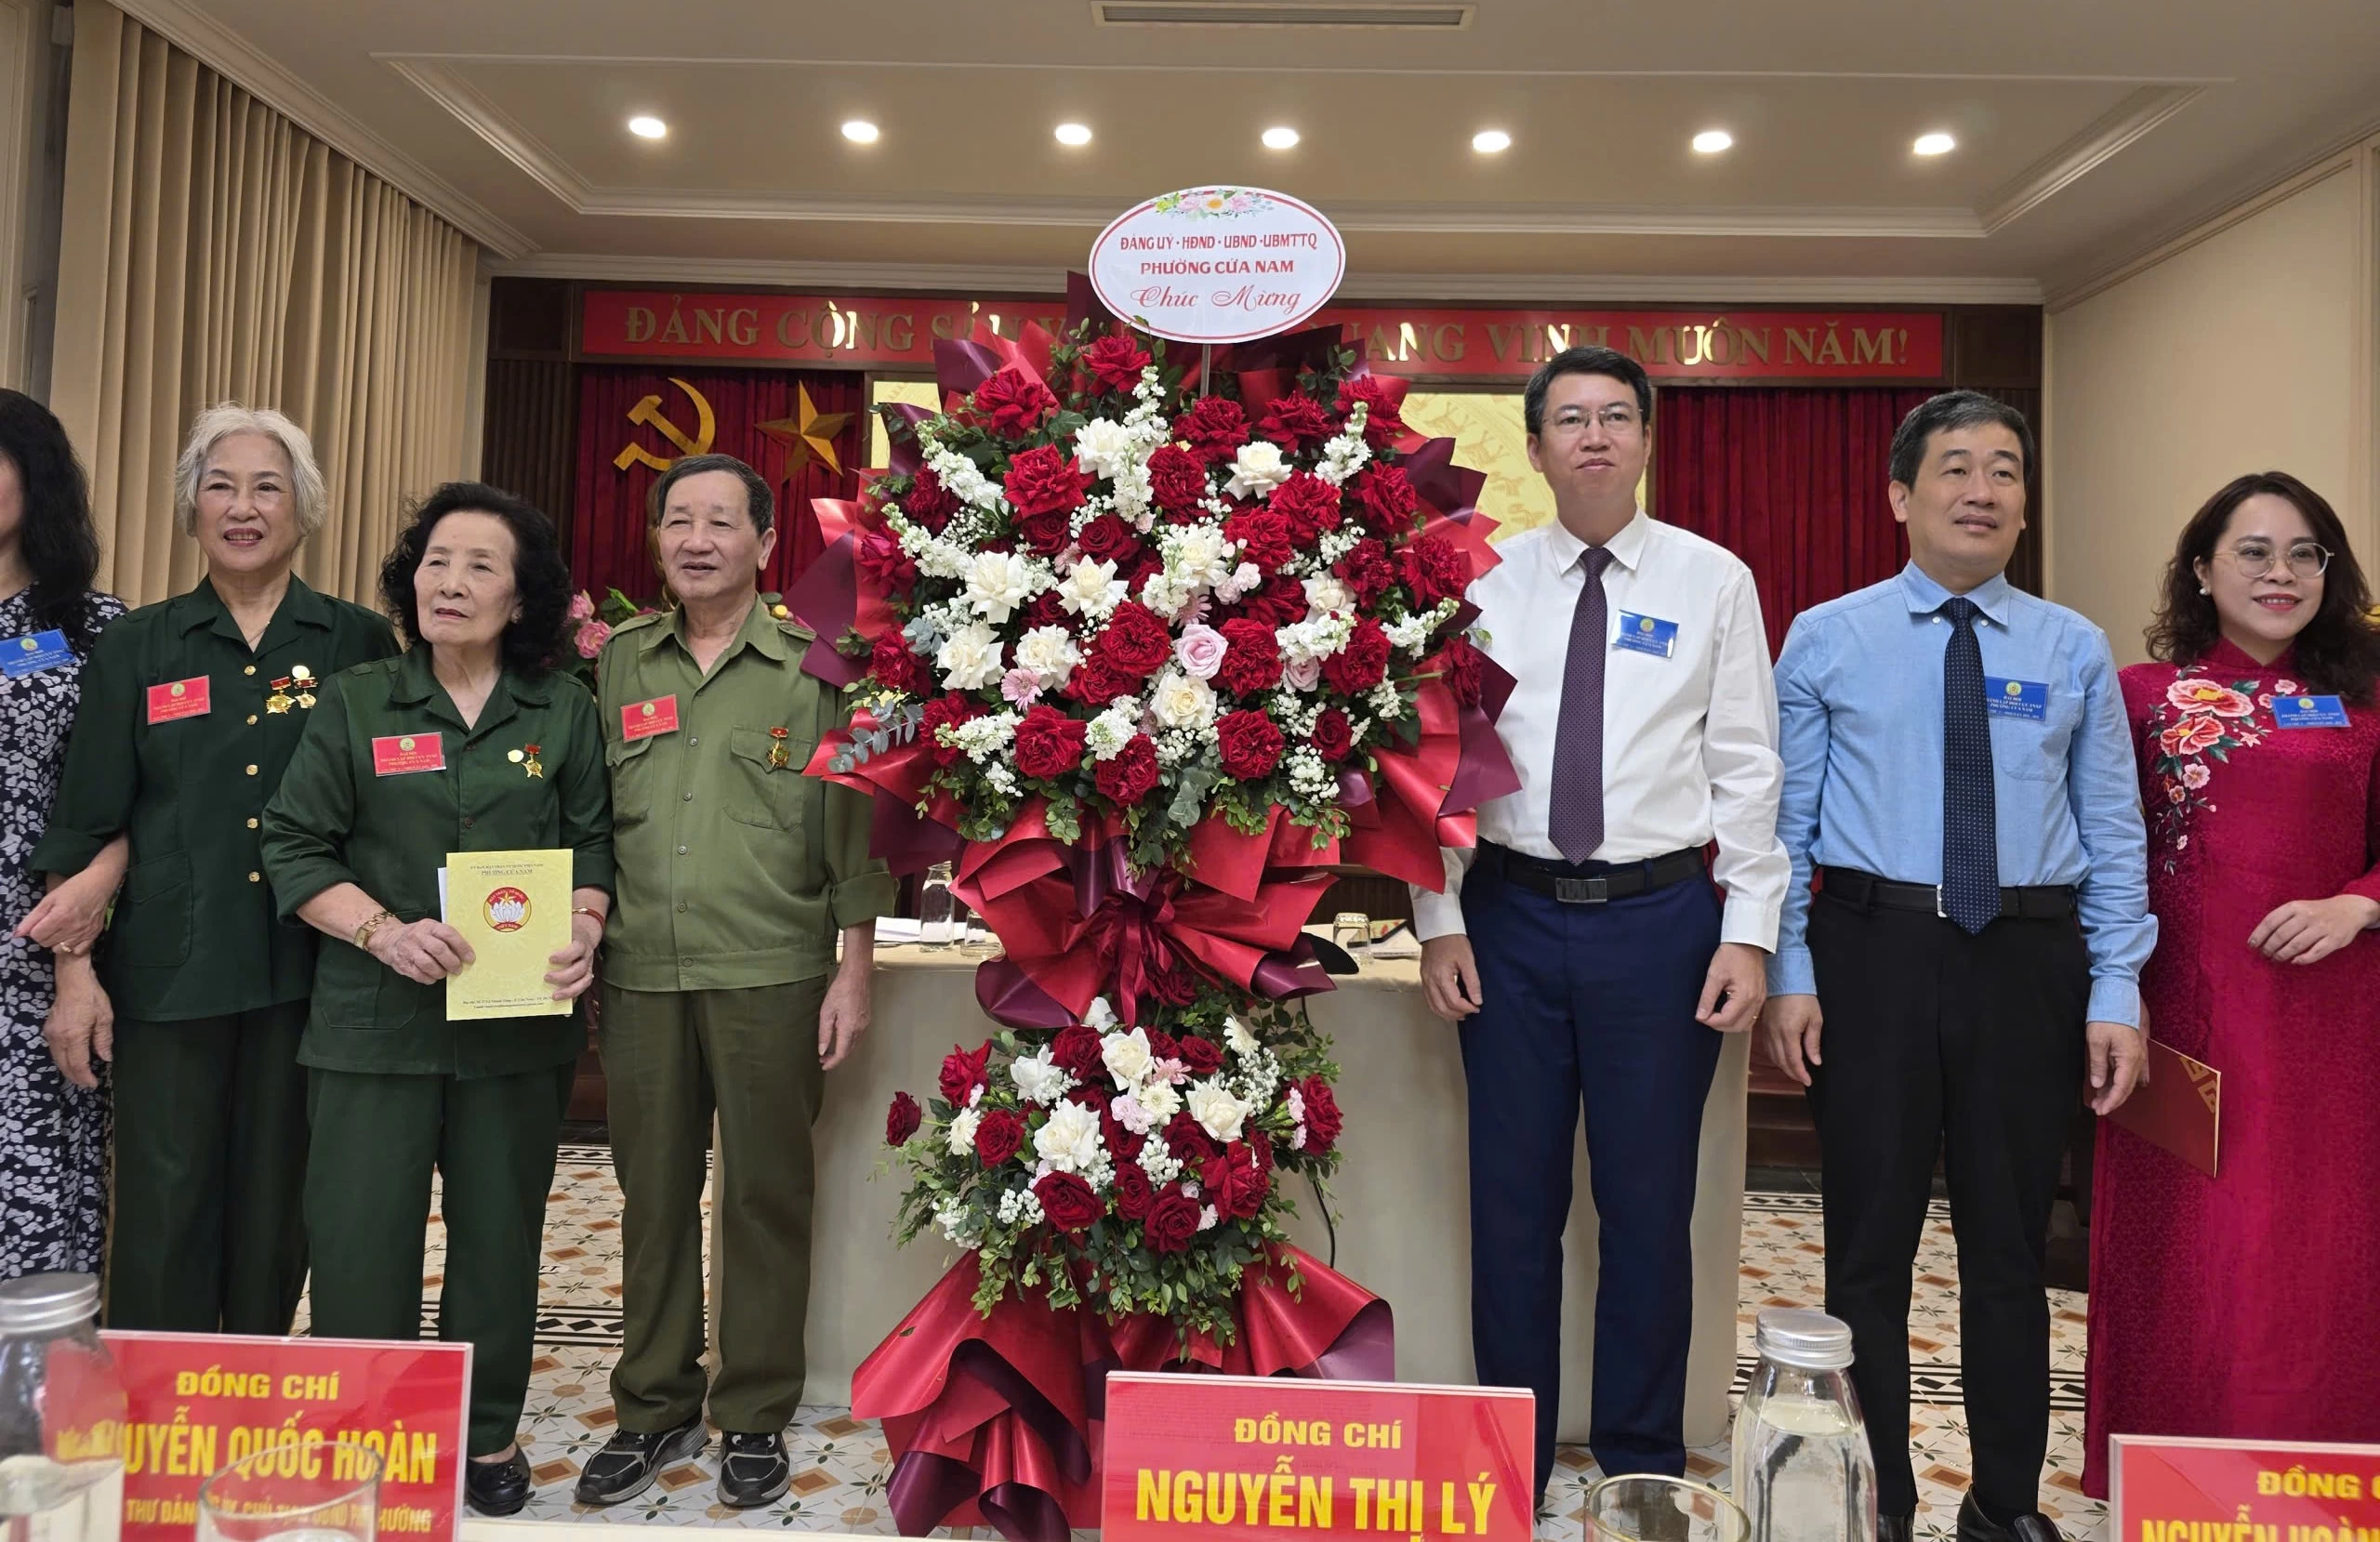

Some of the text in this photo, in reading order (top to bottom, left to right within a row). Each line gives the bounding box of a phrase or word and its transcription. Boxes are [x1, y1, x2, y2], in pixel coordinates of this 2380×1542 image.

[1120, 233, 1155, 250] ĐẢNG
[1182, 236, 1215, 250] HĐND
[1224, 235, 1257, 248] UBND
[1263, 232, 1317, 250] UBMTTQ
[1141, 257, 1294, 274] PHƯỜNG CỬA NAM
[1130, 284, 1301, 315] Chúc Mừng
[624, 295, 759, 345] ĐẢNG
[776, 300, 916, 358] CỘNG
[1627, 316, 1770, 365] MUÔN
[1783, 322, 1909, 365] NĂM!
[282, 1371, 340, 1401] CHÍ
[228, 1409, 324, 1481] QUỐC
[333, 1419, 437, 1484] HOÀN
[1235, 1411, 1402, 1449] ĐỒNG CHÍ
[1136, 1455, 1497, 1542] NGUYỄN THỊ LÝ
[2256, 1464, 2362, 1500] ĐỒNG
